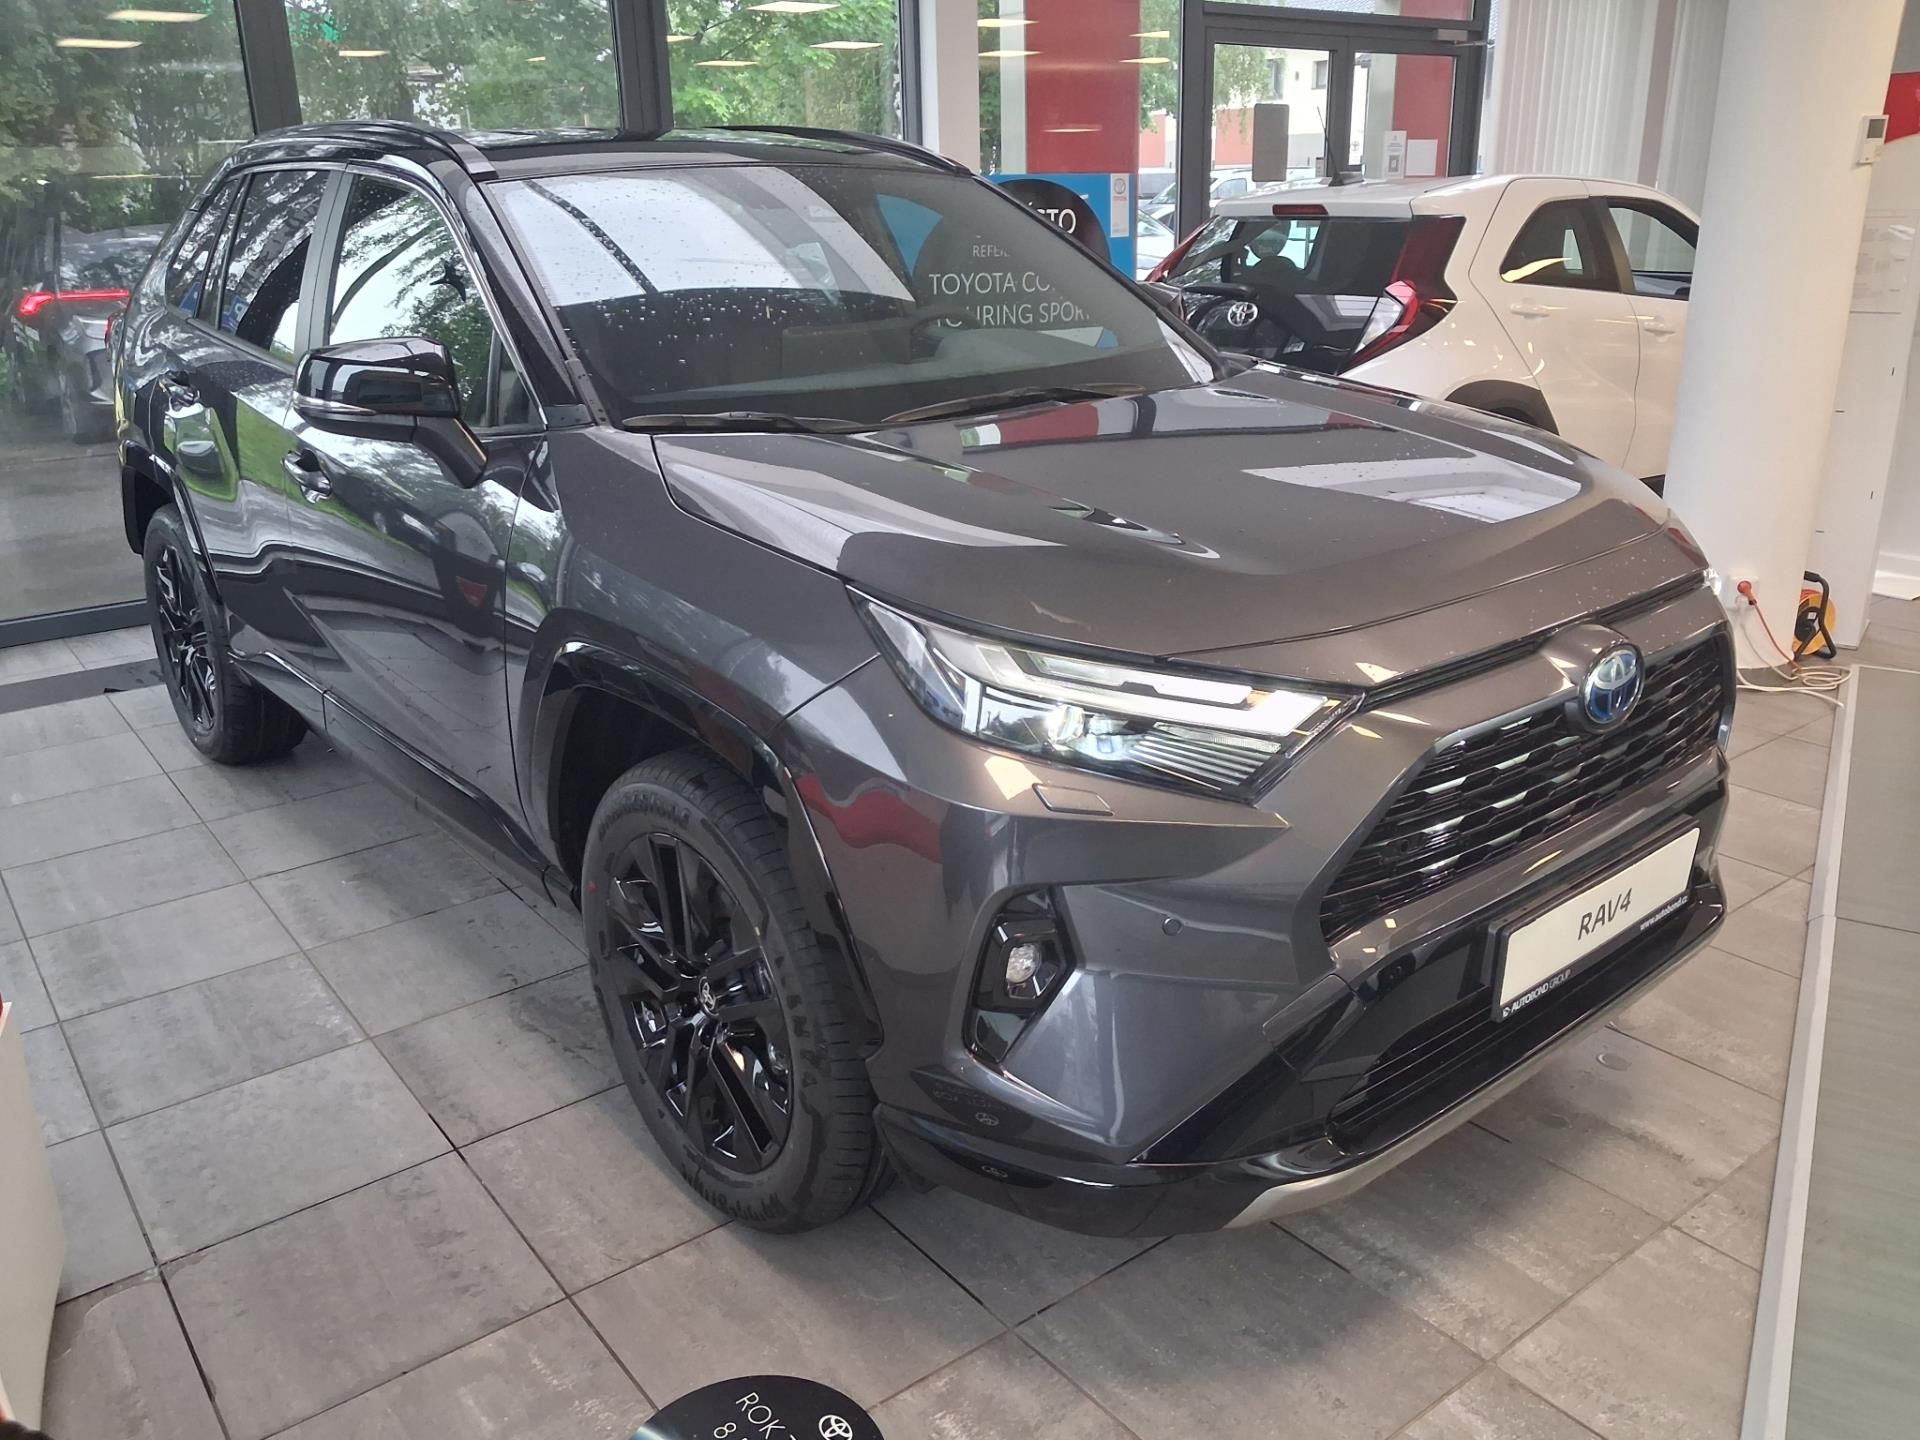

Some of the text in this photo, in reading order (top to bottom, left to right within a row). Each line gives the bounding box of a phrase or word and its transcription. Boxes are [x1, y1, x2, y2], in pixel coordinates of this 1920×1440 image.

[928, 272, 1017, 295] TOYOTA
[1039, 301, 1090, 323] SPOR
[1577, 887, 1633, 941] RAV4
[1510, 982, 1549, 1013] AUTOBOND
[735, 1392, 787, 1440] ROK
[713, 1422, 737, 1439] 8
